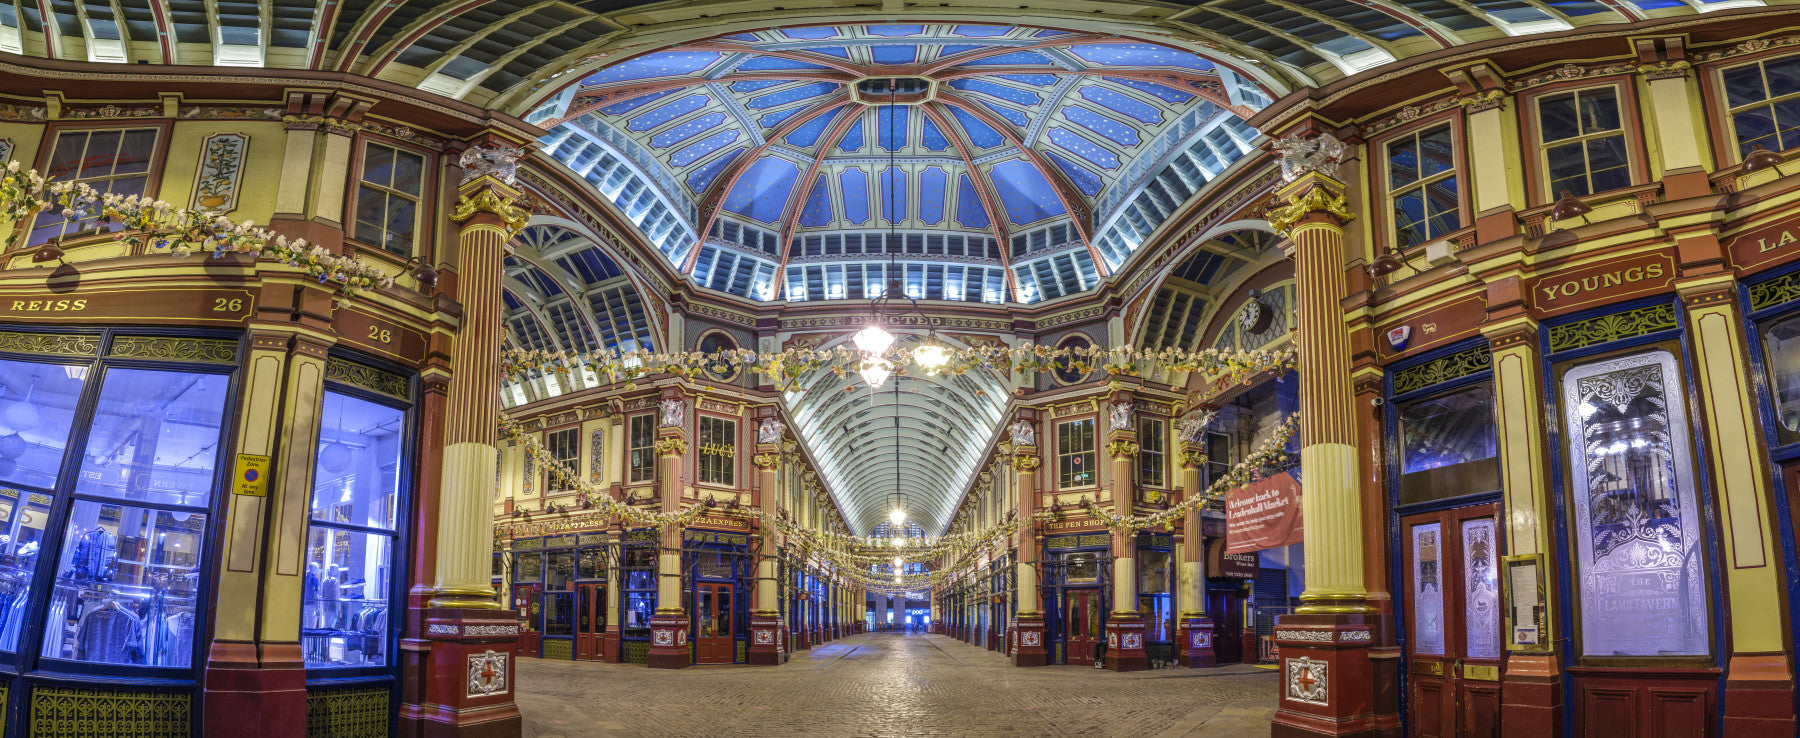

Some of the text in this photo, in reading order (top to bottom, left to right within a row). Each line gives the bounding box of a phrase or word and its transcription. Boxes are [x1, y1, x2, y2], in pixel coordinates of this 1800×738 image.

[577, 207, 635, 261] MARKET
[1757, 229, 1800, 254] LA
[1543, 263, 1664, 301] YOUNGS
[10, 299, 87, 311] REISS
[213, 298, 242, 312] 26
[851, 315, 942, 326] ERECTED
[368, 325, 391, 344] 26
[702, 442, 735, 457] LUC'S
[1228, 489, 1279, 509] Welcome back to
[1229, 496, 1289, 519] Leadenhall Market
[685, 516, 747, 528] PZZAEXPRESS
[1084, 519, 1104, 527] SHOP
[1224, 551, 1255, 562] Brokers
[1631, 578, 1651, 586] THE
[1635, 598, 1679, 610] TAVERN
